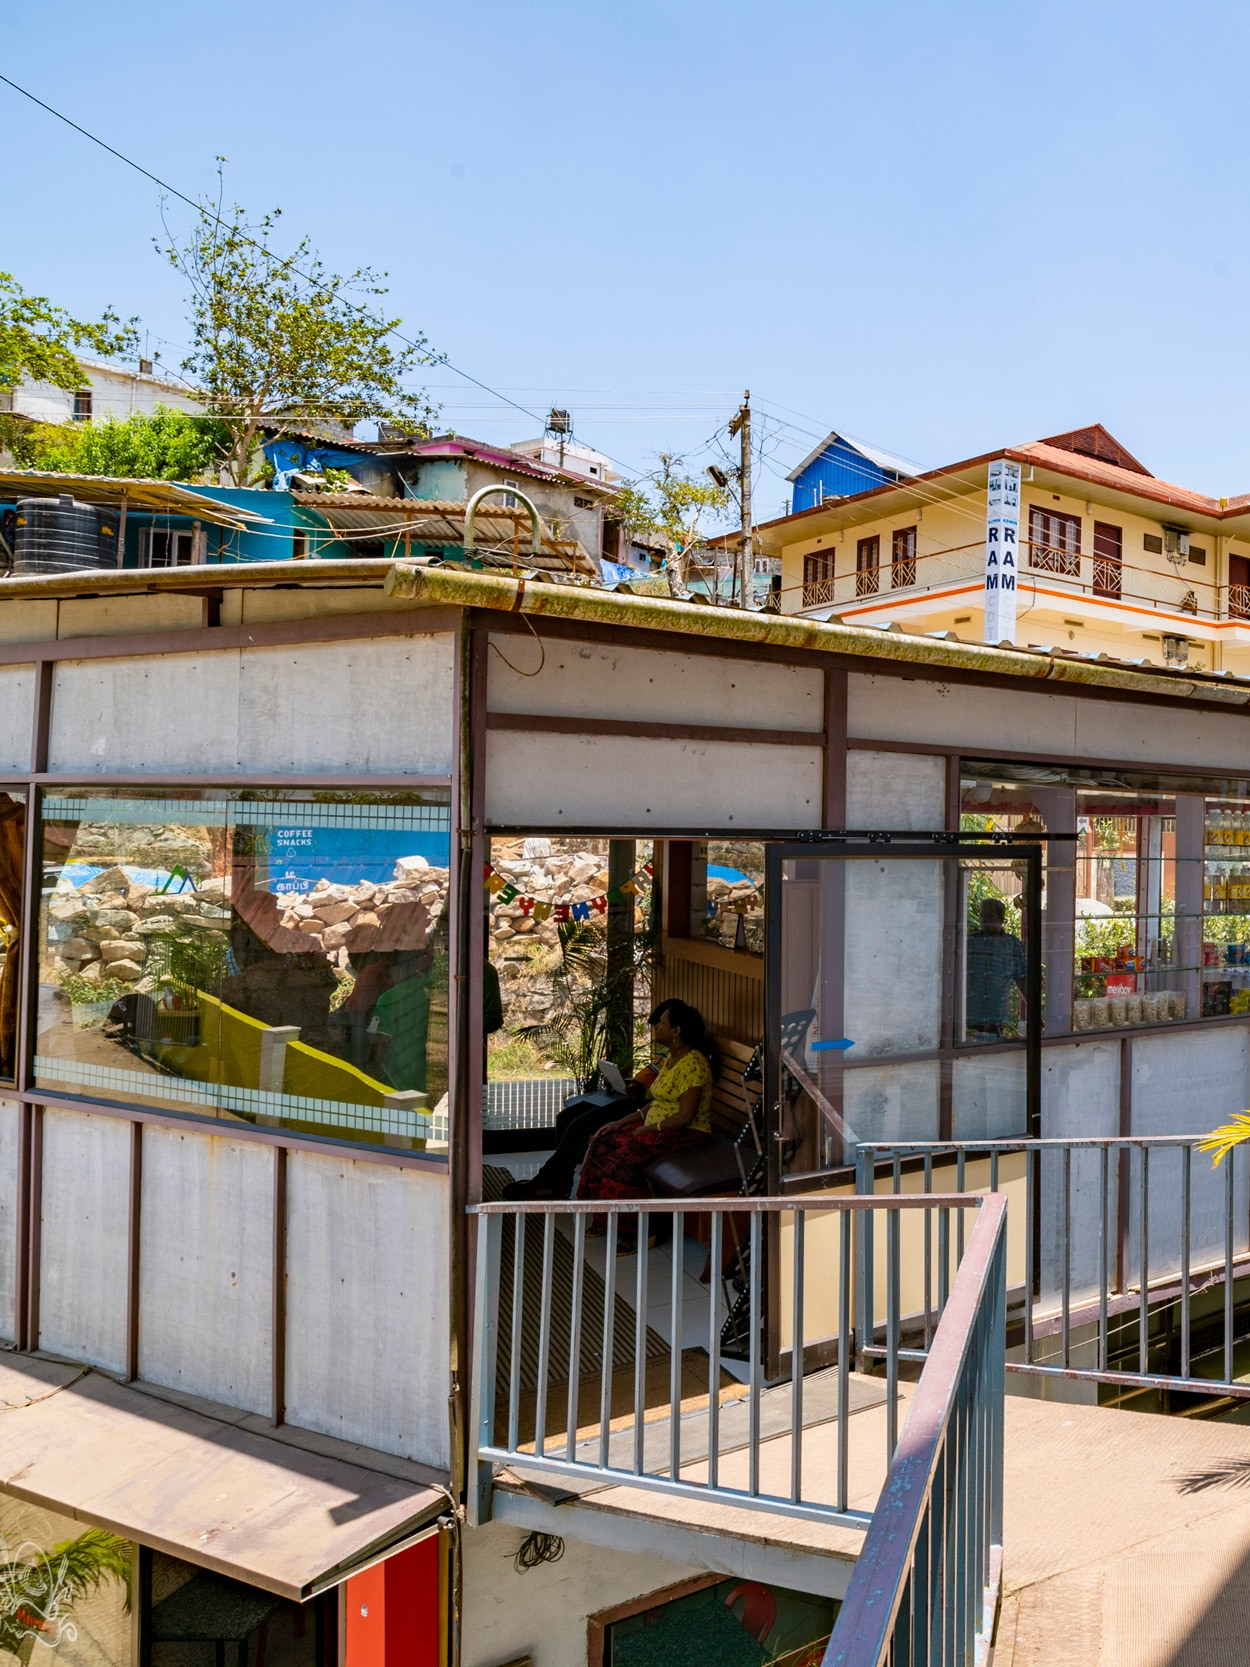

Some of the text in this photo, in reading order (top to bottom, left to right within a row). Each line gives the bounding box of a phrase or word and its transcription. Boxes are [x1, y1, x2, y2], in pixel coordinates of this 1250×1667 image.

[986, 527, 998, 591] RAM
[1001, 526, 1016, 591] RAM
[277, 829, 313, 838] COFFEE
[277, 838, 312, 847] SNACKS
